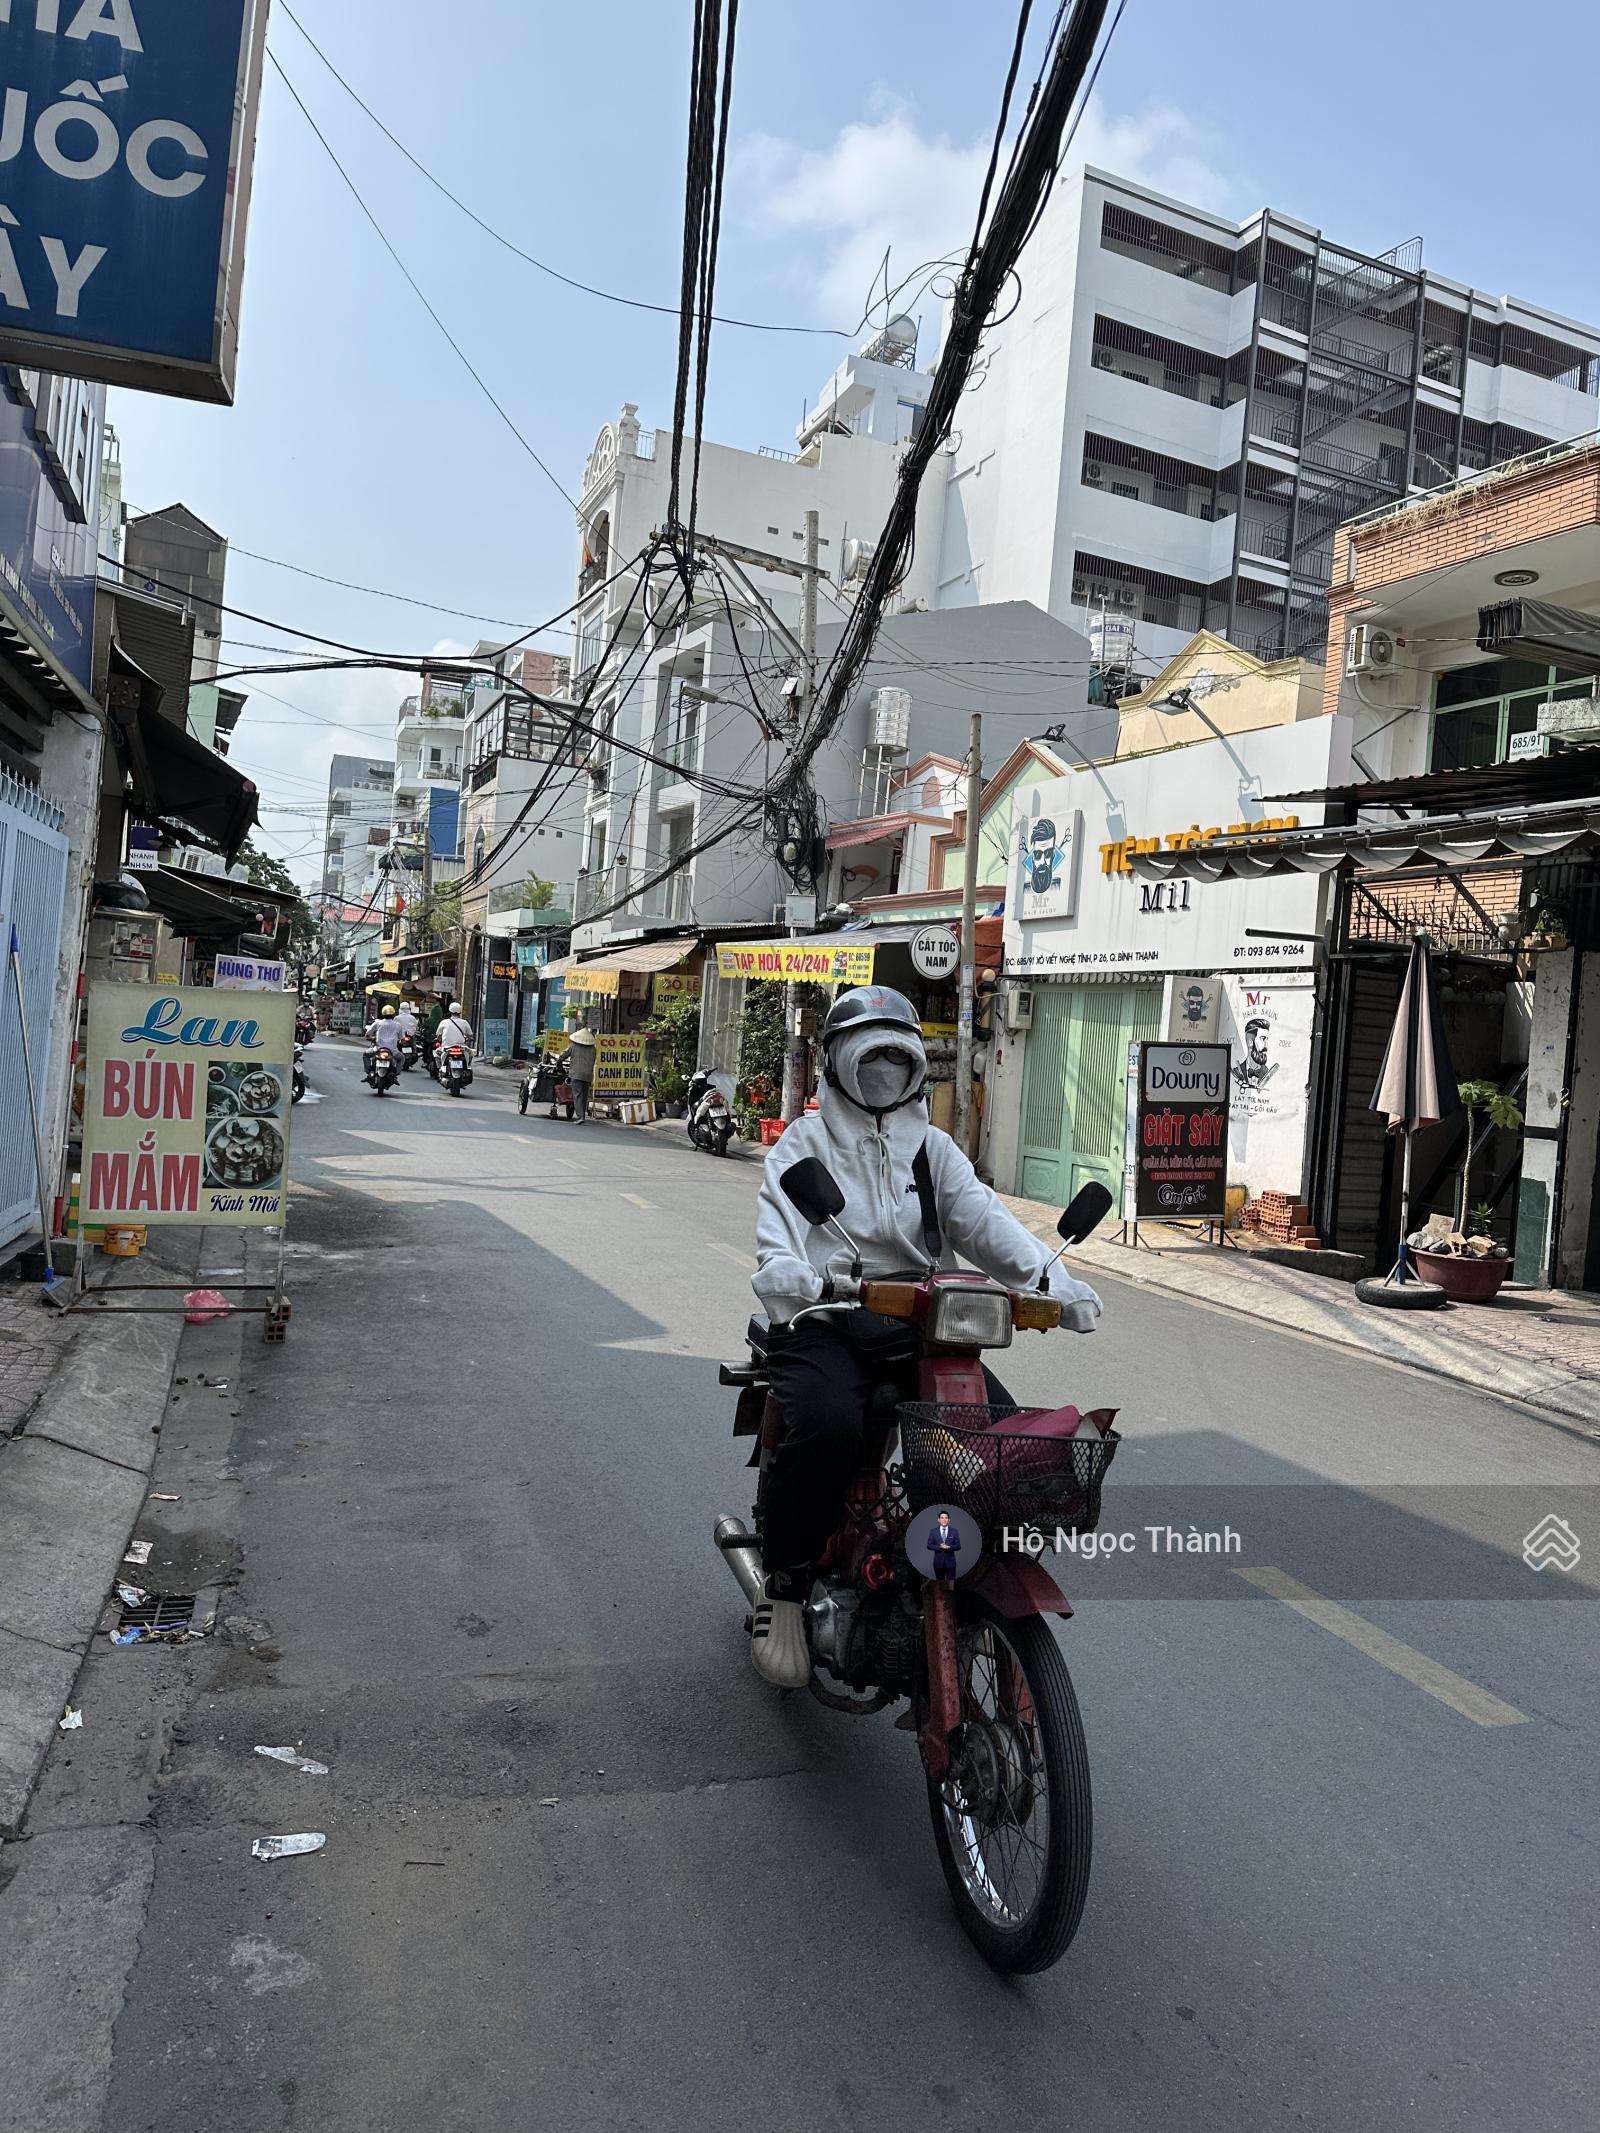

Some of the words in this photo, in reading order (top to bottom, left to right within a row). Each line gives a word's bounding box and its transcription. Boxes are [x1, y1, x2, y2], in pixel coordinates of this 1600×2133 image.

[1512, 735, 1541, 749] 685/91
[1031, 894, 1050, 909] Mr
[918, 937, 936, 952] CẮT
[938, 939, 956, 953] TÓC
[1234, 947, 1247, 957] ĐT:
[1247, 946, 1263, 957] 093
[1265, 946, 1280, 955] 874
[1283, 944, 1304, 955] 9264
[734, 952, 754, 974] TẠP
[786, 952, 830, 974] 24/24h
[926, 956, 948, 968] NAM
[1046, 952, 1058, 964] VIẾT
[1059, 952, 1076, 965] NGHỆ
[1135, 951, 1159, 963] THẠNH
[257, 965, 281, 982] THƠ
[1246, 991, 1271, 1007] Mr
[120, 997, 265, 1048] Lan
[598, 1067, 621, 1079] CANH
[1152, 1066, 1220, 1097] Downy
[102, 1048, 195, 1120] BÚN
[1144, 1107, 1185, 1153] GIẶT
[1188, 1106, 1224, 1147] SẤY
[88, 1131, 200, 1212] MẮM
[210, 1195, 245, 1213] Kính
[249, 1195, 281, 1213] Mời
[1157, 1183, 1207, 1212] Comfort
